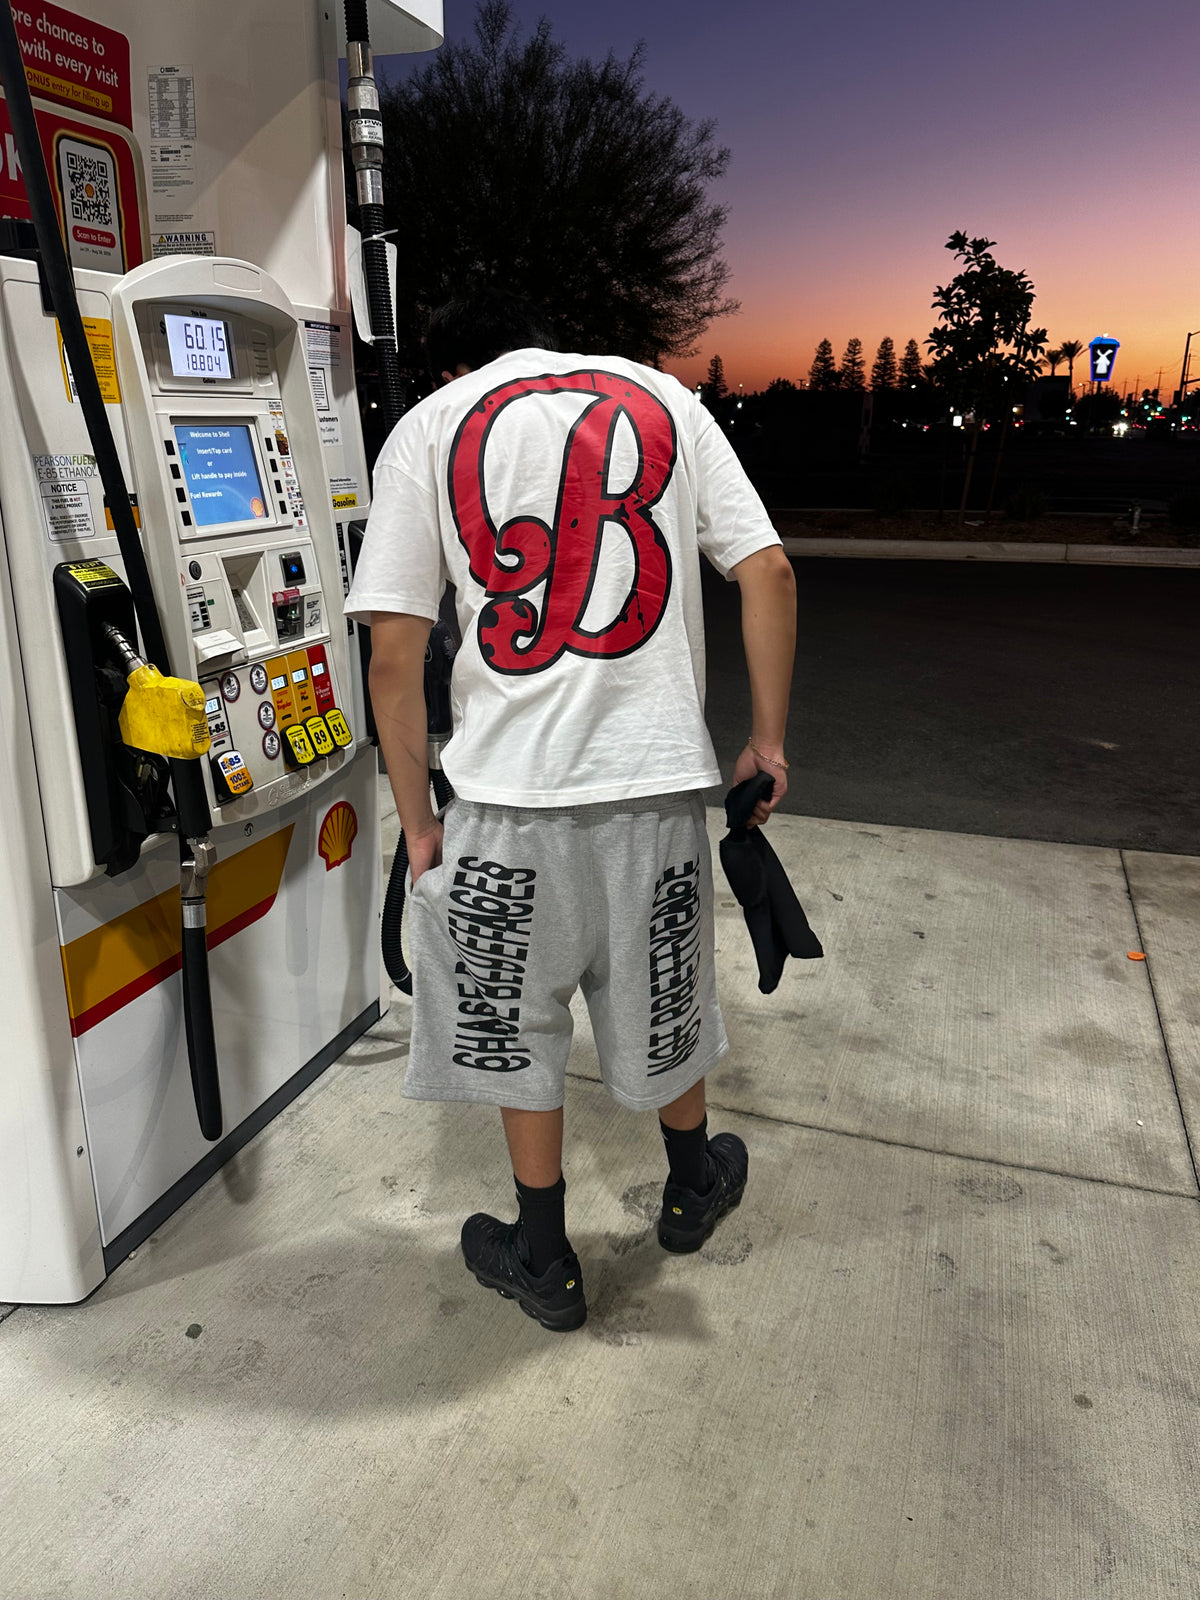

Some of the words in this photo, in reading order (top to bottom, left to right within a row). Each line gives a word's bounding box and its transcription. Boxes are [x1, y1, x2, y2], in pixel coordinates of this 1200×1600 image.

[10, 6, 32, 27] ore
[36, 12, 89, 50] chances
[92, 37, 105, 57] to
[20, 37, 51, 63] with
[55, 52, 92, 82] every
[95, 64, 119, 88] visit
[26, 70, 50, 87] ONUS
[51, 81, 71, 96] entry
[71, 84, 81, 97] for
[101, 98, 110, 108] up
[76, 229, 90, 240] Scan
[90, 233, 97, 242] to
[97, 233, 112, 244] Enter
[165, 233, 207, 243] WARNING
[184, 323, 225, 352] 60.15
[187, 354, 221, 372] 18.804
[38, 467, 58, 479] E-85
[58, 466, 98, 479] ETHANOL
[50, 483, 78, 493] NOTICE
[201, 490, 223, 498] Rewards
[332, 497, 356, 507] Gasoline
[447, 369, 678, 676] B
[313, 729, 328, 745] 89
[332, 721, 346, 737] 91
[233, 780, 251, 791] OCTANE
